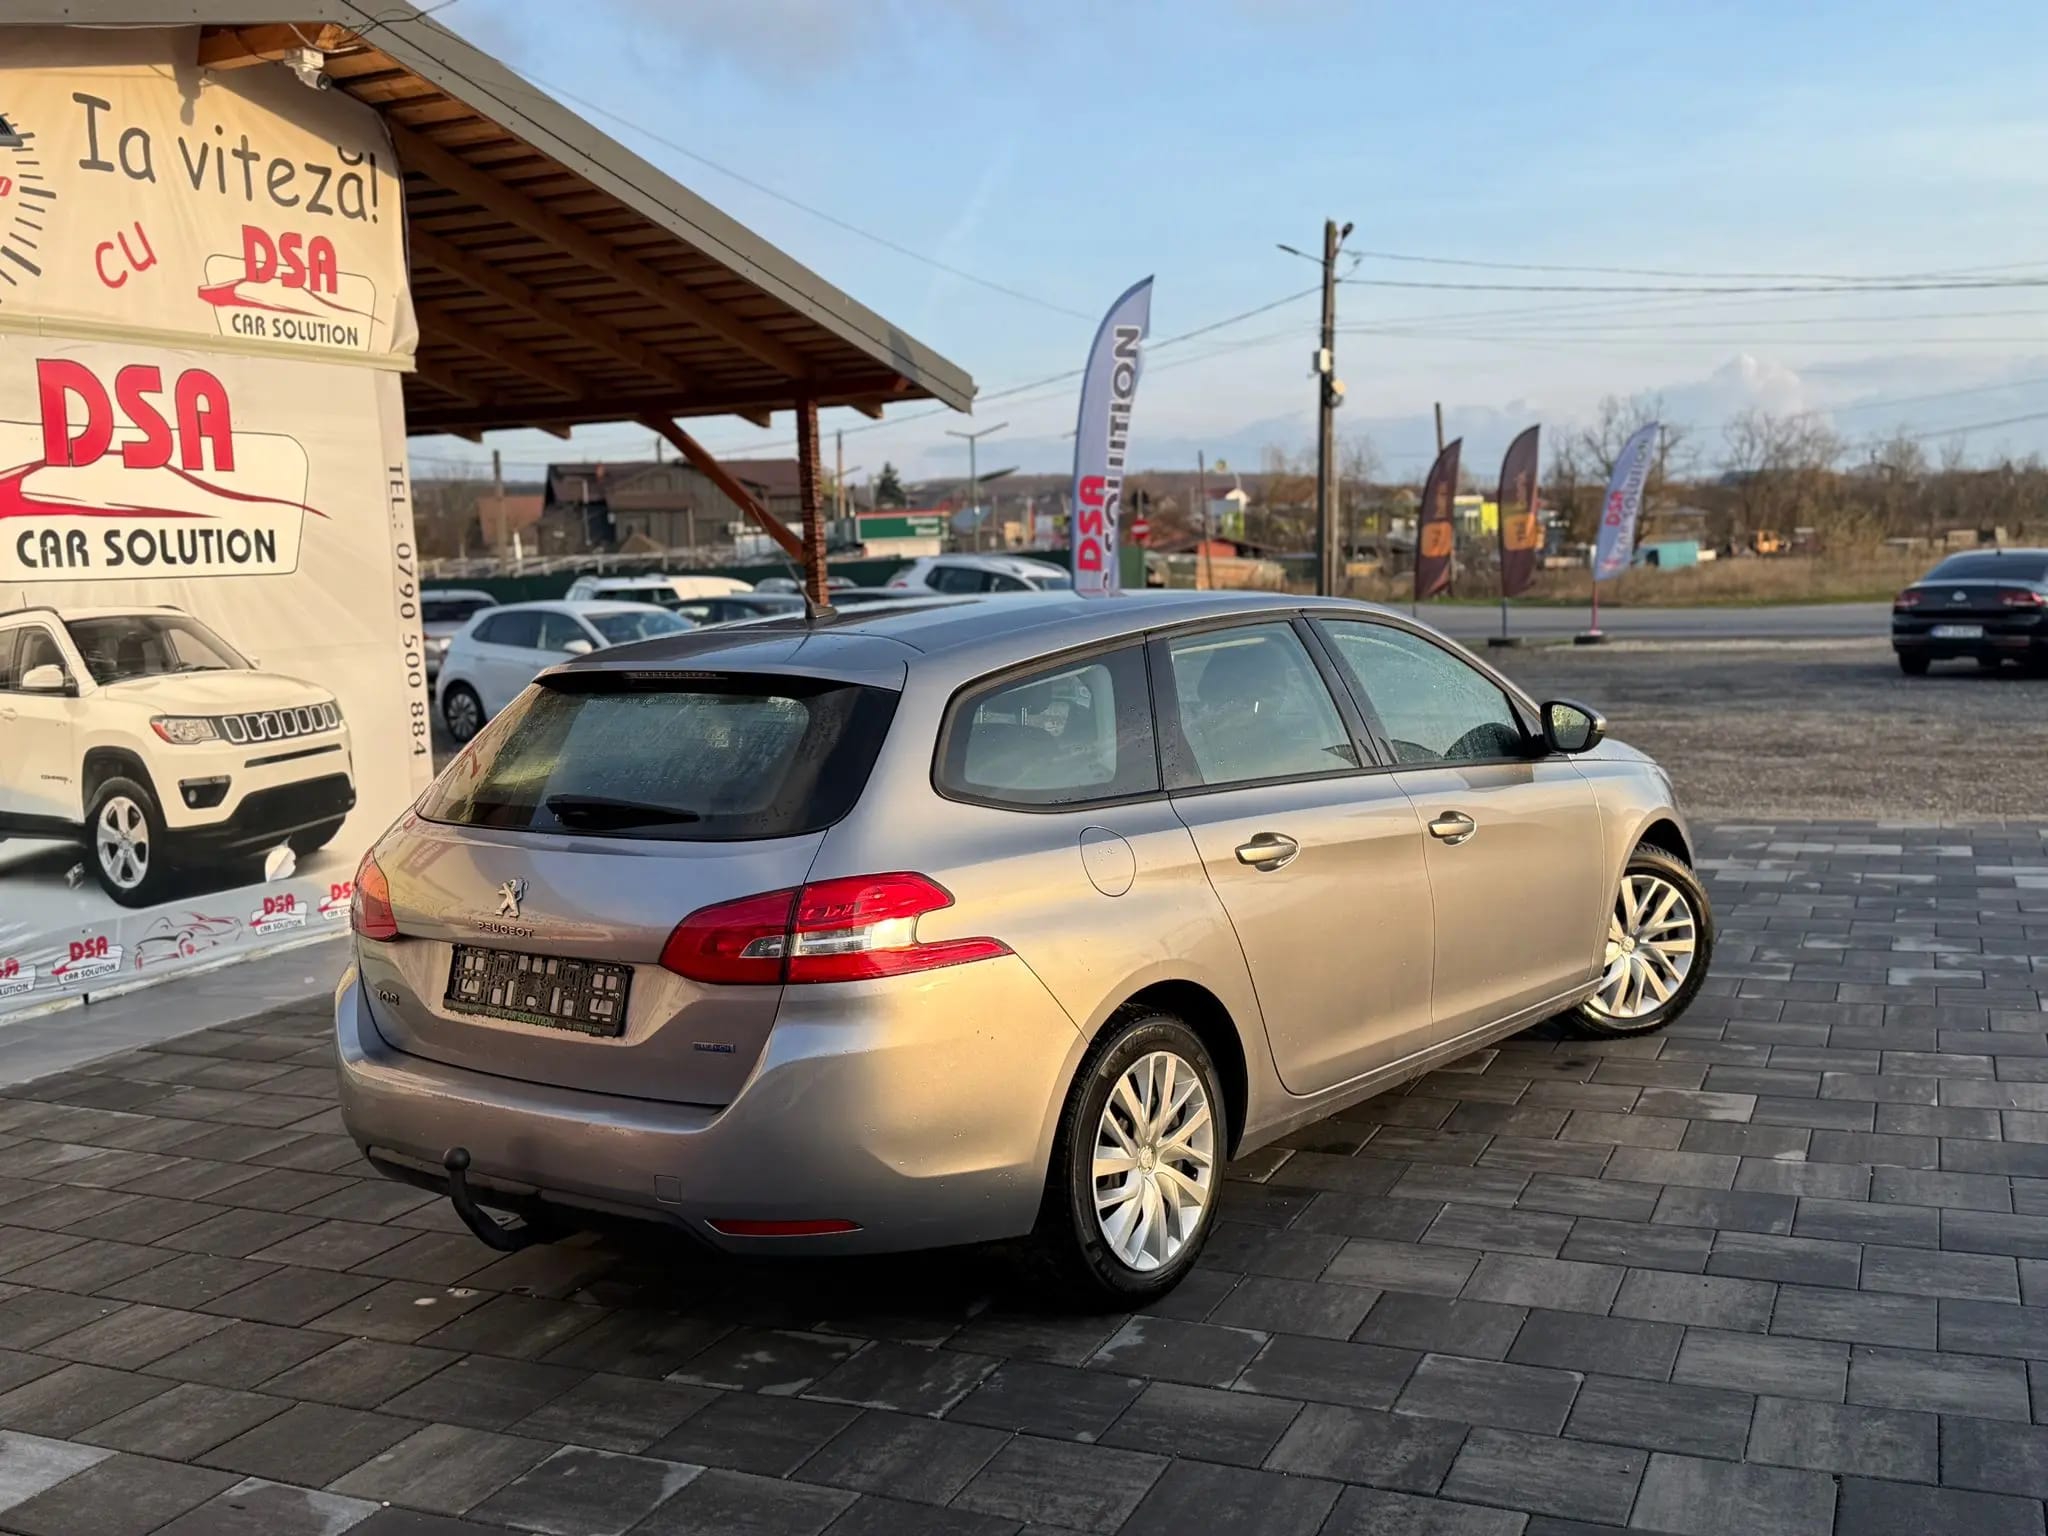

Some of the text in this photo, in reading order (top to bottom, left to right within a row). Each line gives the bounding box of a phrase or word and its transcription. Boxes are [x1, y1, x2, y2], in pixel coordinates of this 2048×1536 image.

[178, 124, 379, 224] viteză!
[242, 224, 337, 294] DSA
[232, 313, 359, 346] CAR SOLUTION
[36, 358, 235, 472] DSA
[1079, 475, 1105, 572] DSA
[1605, 491, 1623, 526] DSA
[16, 528, 276, 569] CAR SOLUTION
[396, 542, 416, 620] 0790
[403, 633, 422, 689] 500
[411, 701, 427, 756] 884
[263, 893, 295, 915] DSA
[331, 882, 353, 901] DS
[477, 921, 534, 938] PEUGEOT
[69, 936, 108, 962] DSA
[63, 963, 116, 982] CAR SOLUTION
[517, 1012, 556, 1027] SOLUTION
